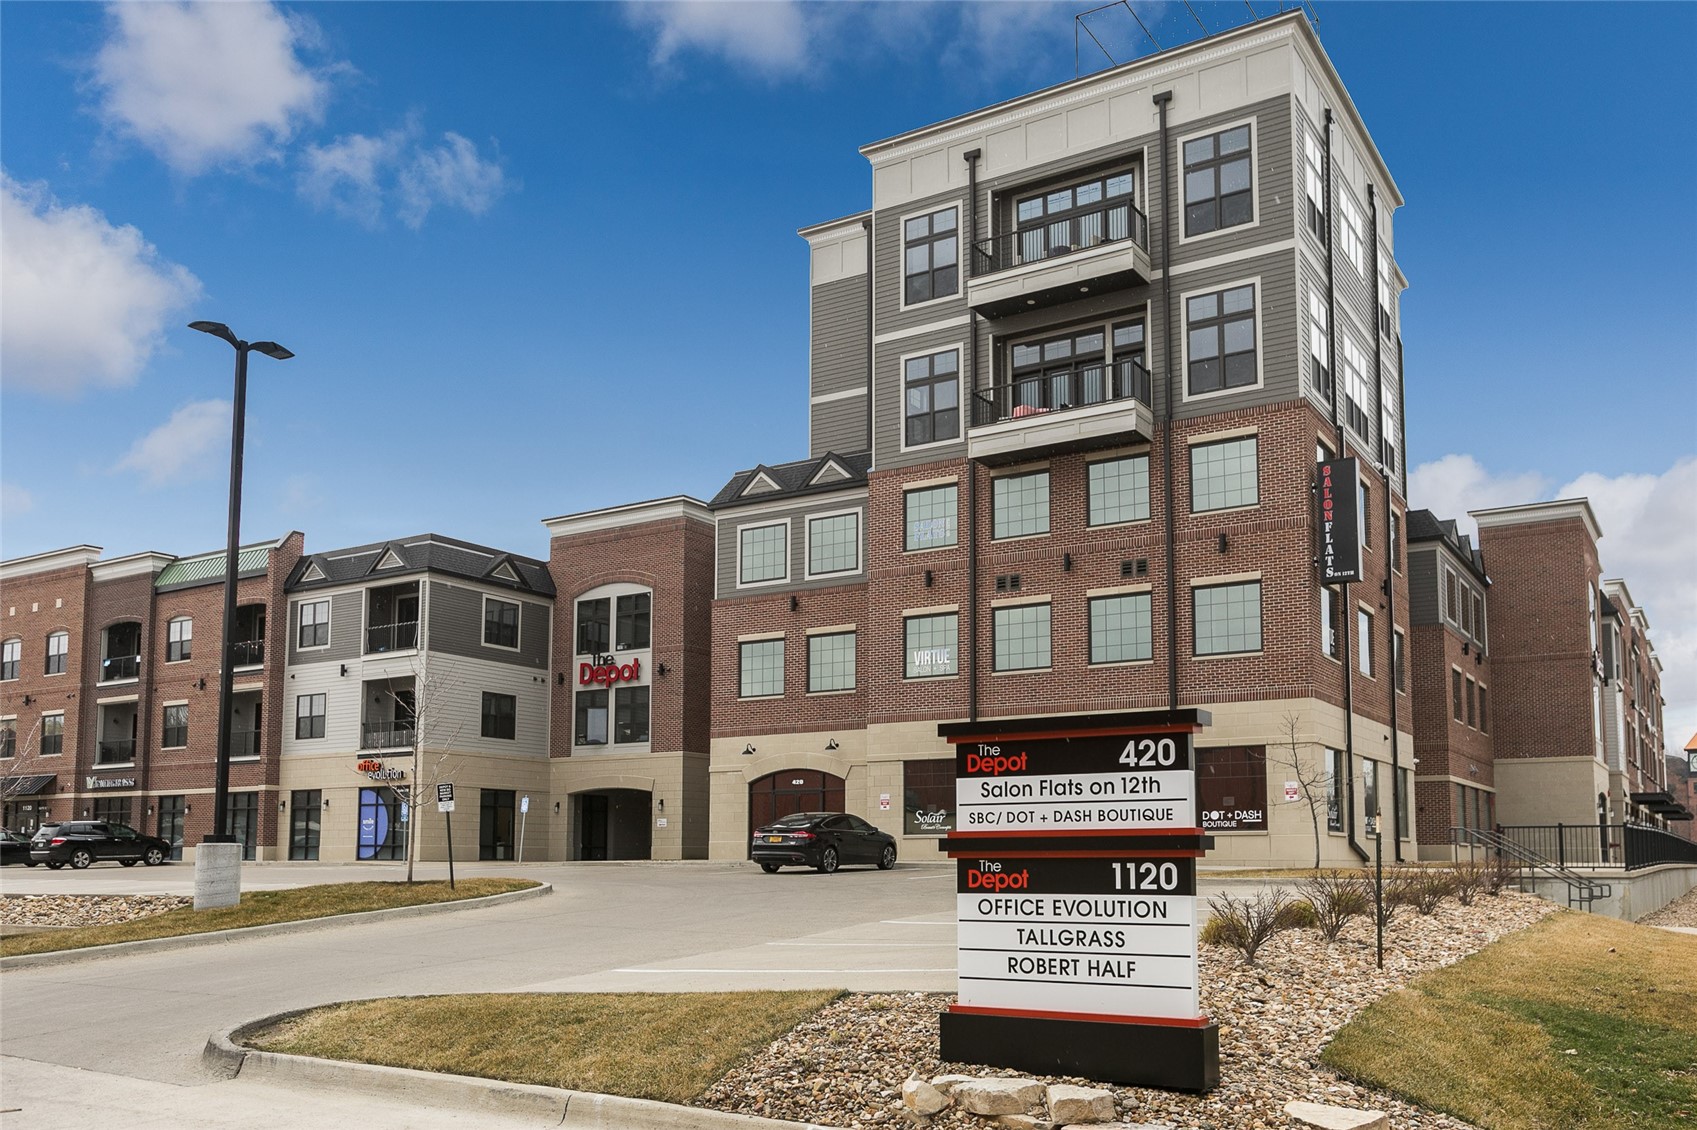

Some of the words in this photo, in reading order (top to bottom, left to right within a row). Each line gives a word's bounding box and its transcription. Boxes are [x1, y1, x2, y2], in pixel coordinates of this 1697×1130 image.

[1323, 465, 1333, 521] SALON
[1325, 522, 1334, 578] FLATS
[590, 653, 615, 666] The
[914, 649, 950, 665] VIRTUE
[579, 658, 640, 688] Depot
[978, 744, 1001, 757] The
[1119, 738, 1176, 767] 420
[357, 759, 381, 772] office
[967, 752, 1028, 776] Depot
[981, 781, 1033, 798] Salon
[1040, 778, 1083, 797] Flats
[1090, 781, 1115, 795] on
[1121, 776, 1161, 794] 12th
[914, 810, 946, 823] Solair
[969, 811, 1002, 825] SBC/
[1006, 811, 1035, 824] DOT
[1040, 814, 1048, 823] +
[1053, 810, 1092, 823] DASH
[1098, 808, 1173, 822] BOUTIQUE
[1202, 811, 1225, 820] DOT
[1235, 810, 1262, 820] DASH
[979, 860, 1001, 872] The
[968, 869, 1029, 892] Depot
[1112, 862, 1178, 891] 1120
[978, 898, 1044, 916] OFFICE
[1053, 899, 1167, 918] EVOLUTION
[1017, 928, 1126, 948] TALLGRASS
[1008, 957, 1080, 976] ROBERT
[1088, 959, 1136, 978] HALF
